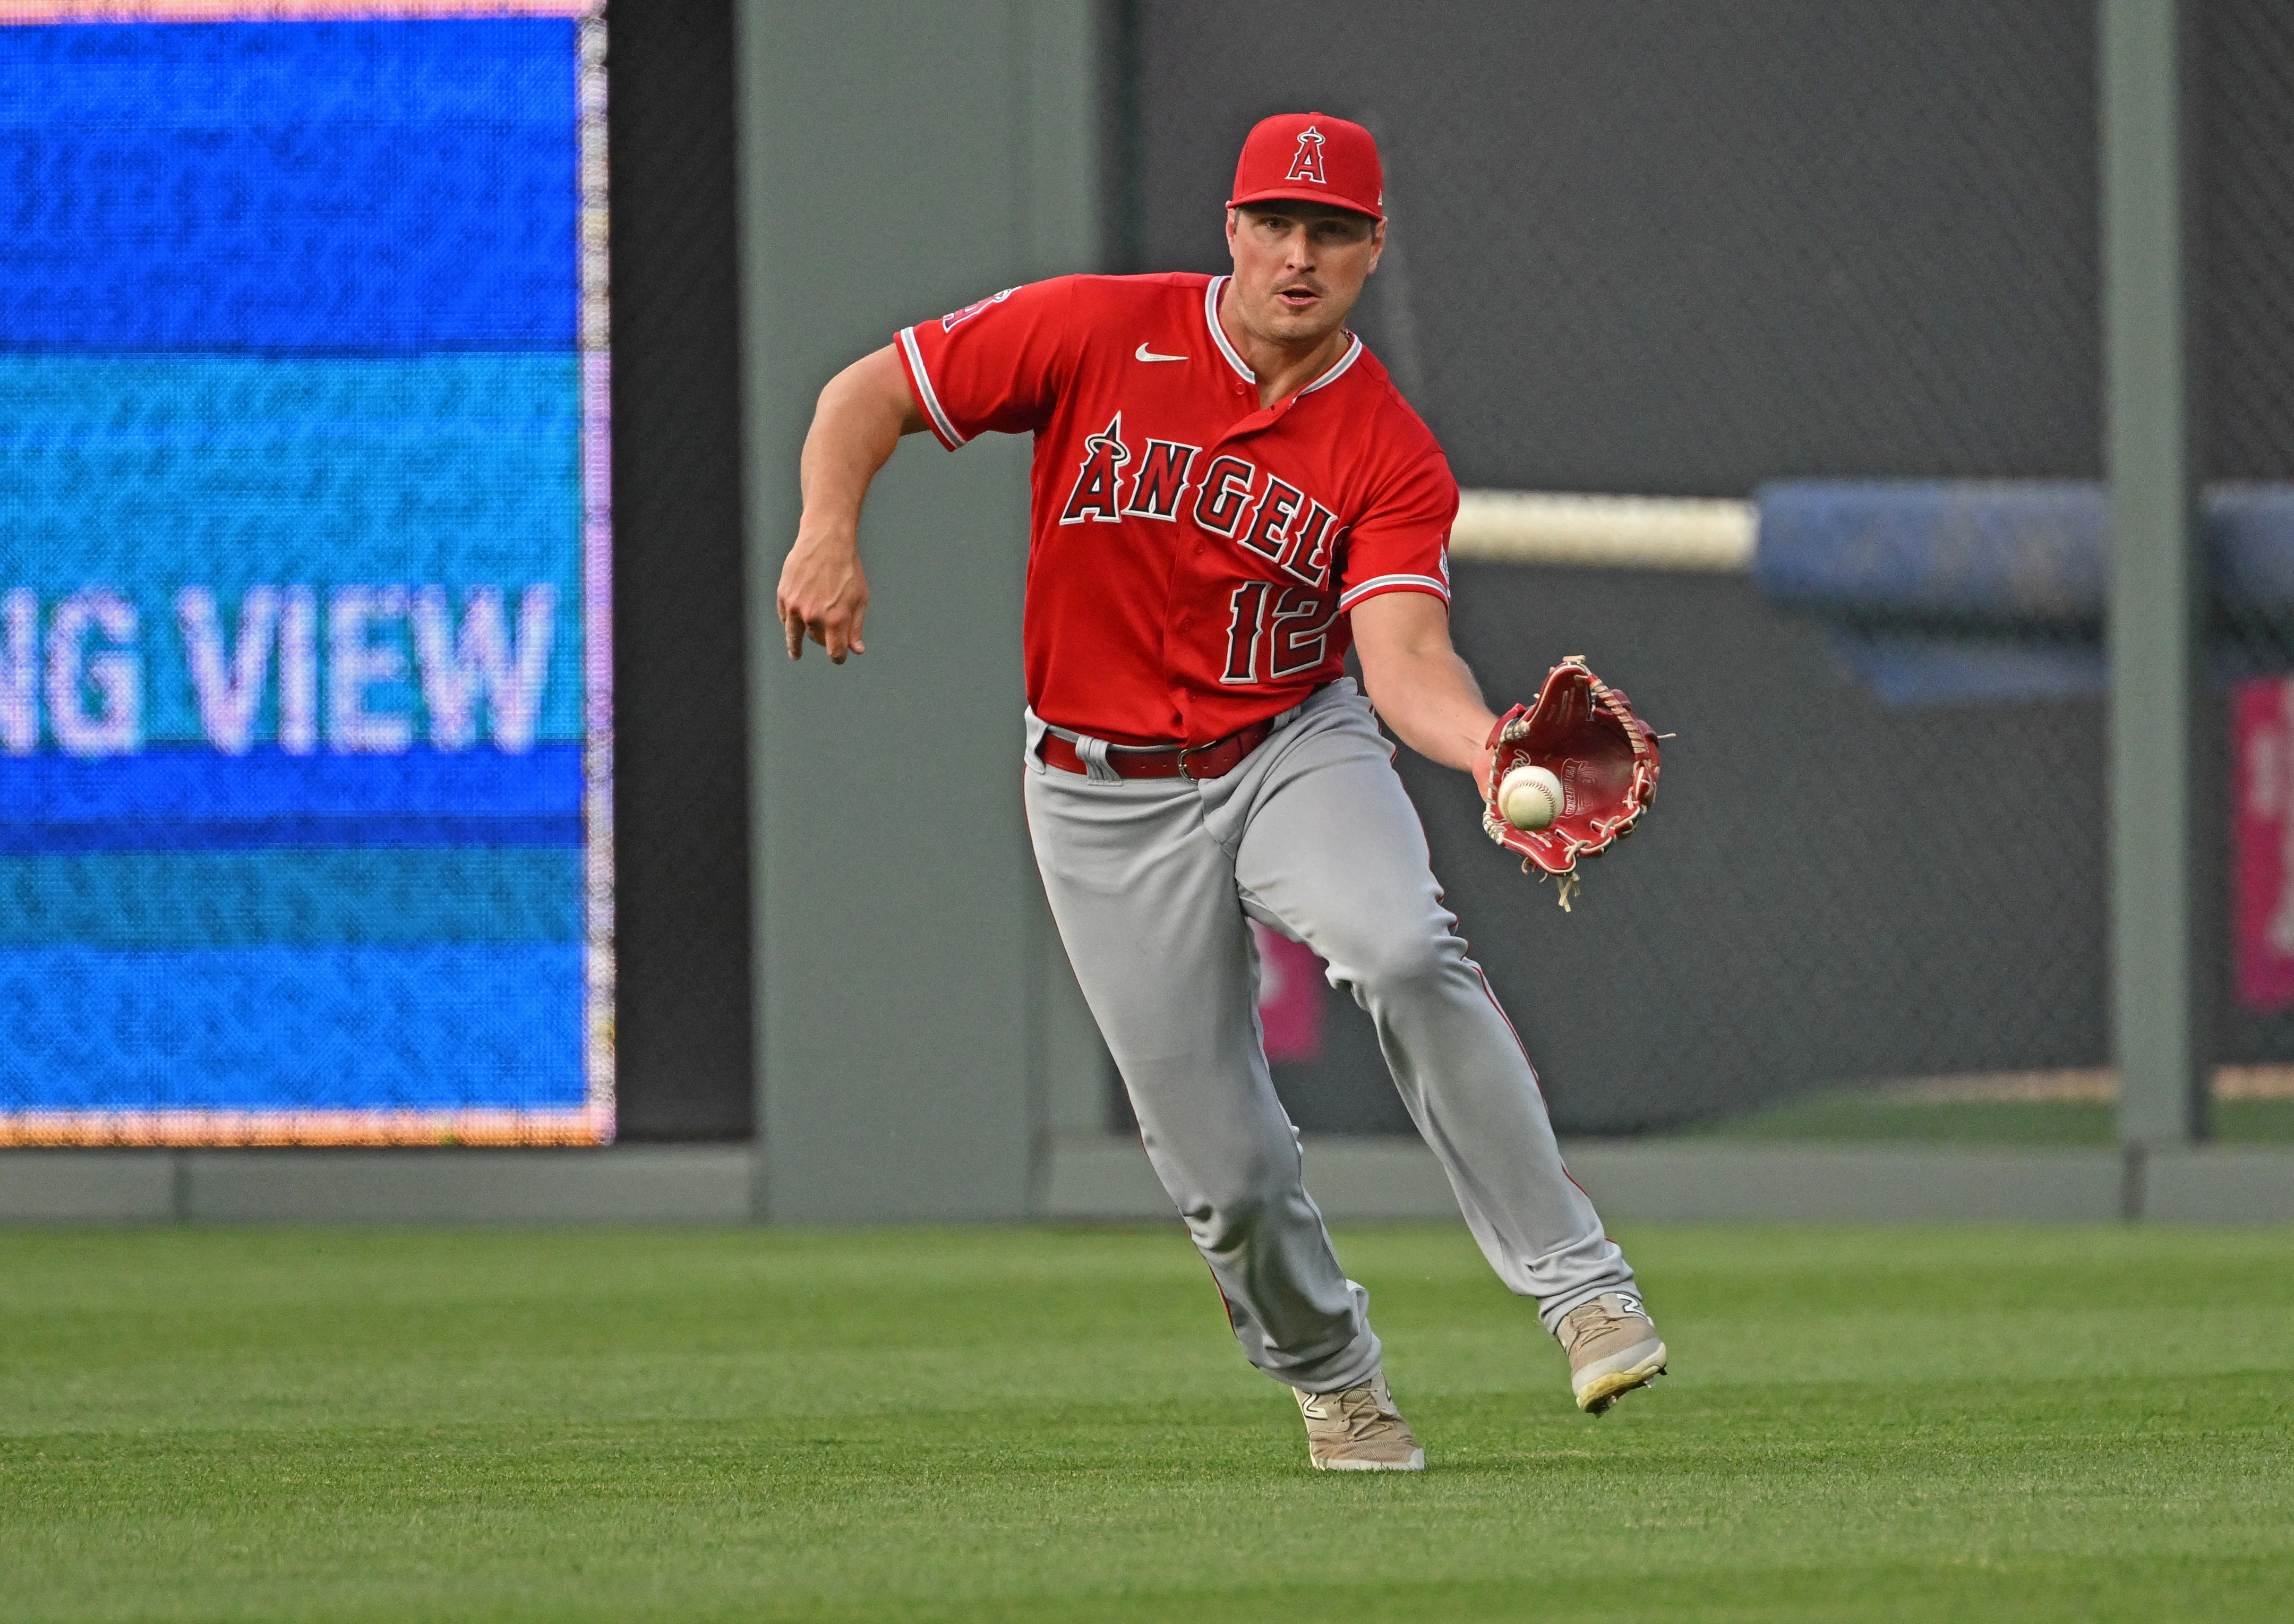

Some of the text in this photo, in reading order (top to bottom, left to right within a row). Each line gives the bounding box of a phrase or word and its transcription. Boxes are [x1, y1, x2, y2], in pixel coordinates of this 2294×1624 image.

[1285, 126, 1327, 184] A
[175, 583, 555, 756] VIEW
[1219, 580, 1341, 684] 12
